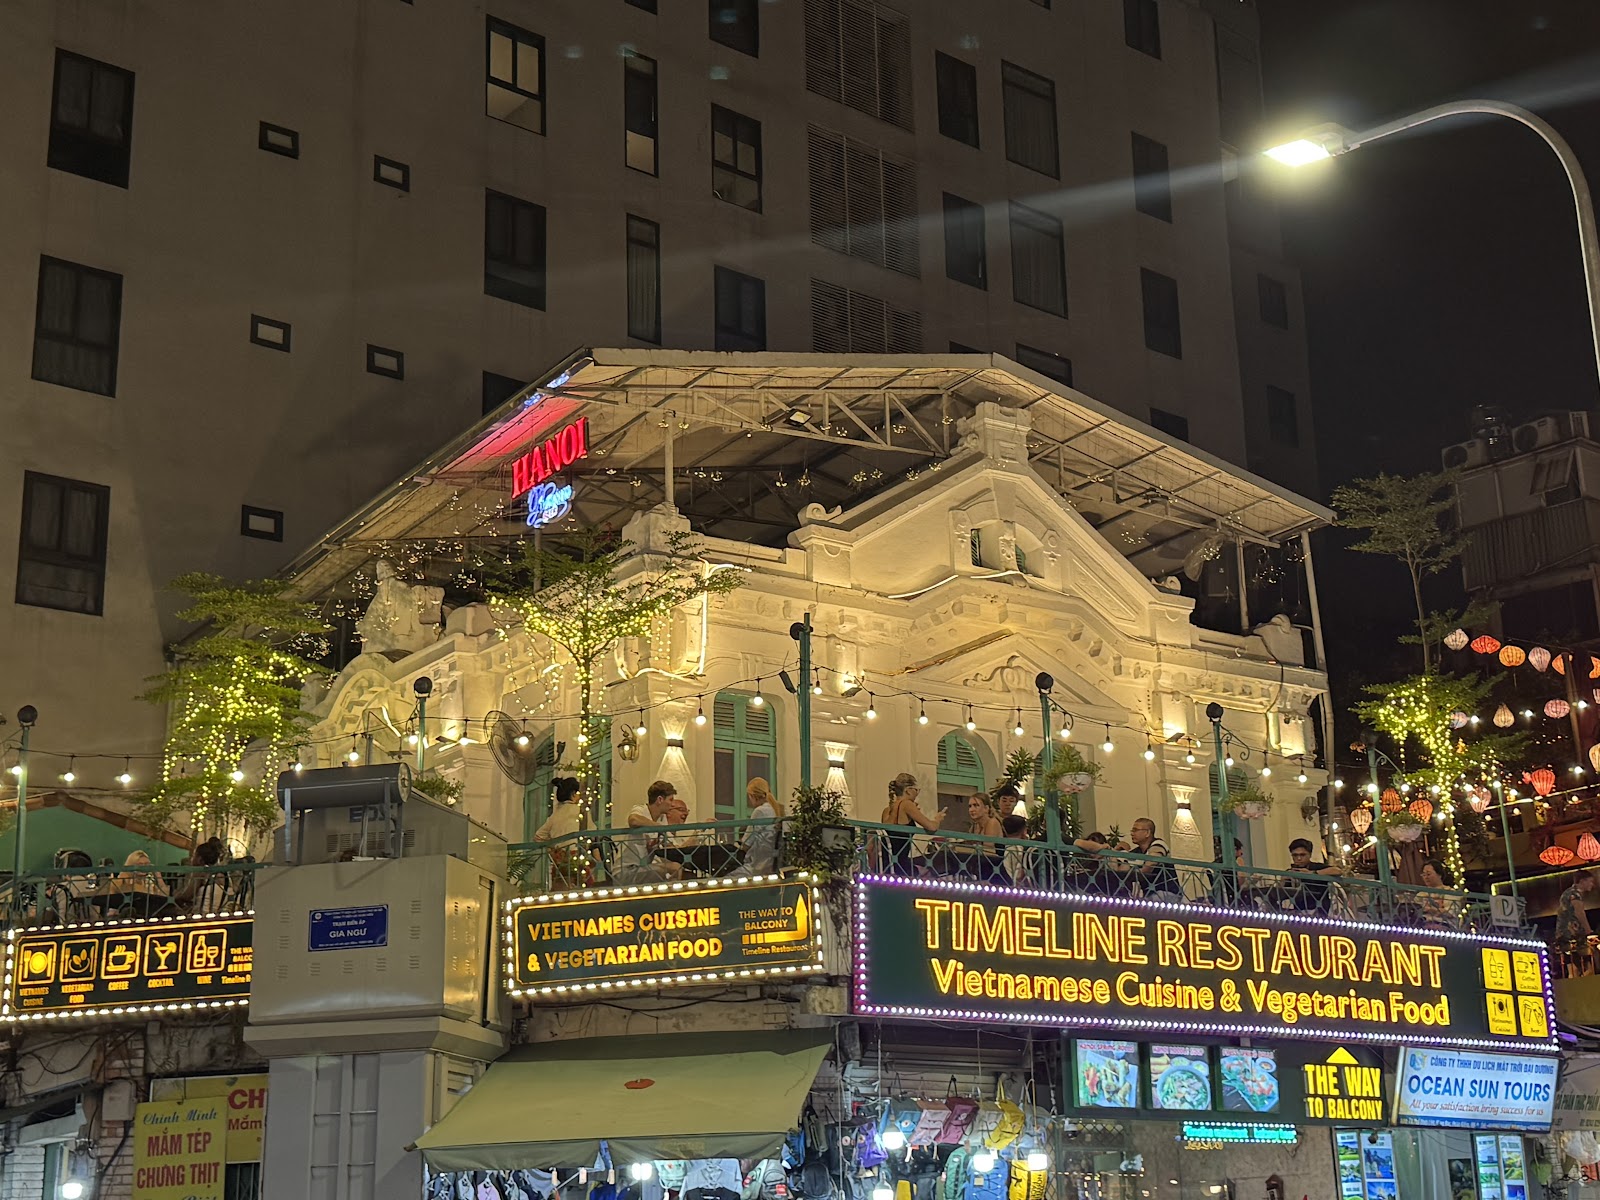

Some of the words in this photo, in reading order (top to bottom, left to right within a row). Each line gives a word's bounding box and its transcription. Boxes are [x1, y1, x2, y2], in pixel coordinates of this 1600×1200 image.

[511, 416, 588, 499] HANOI
[739, 910, 756, 919] THE
[758, 908, 778, 917] WAY
[781, 906, 793, 916] TO
[329, 930, 345, 938] GIA
[528, 913, 635, 941] VIETNAMES
[639, 907, 720, 932] CUISINE
[744, 919, 788, 931] BALCONY
[742, 947, 770, 956] Timeline
[915, 898, 1148, 965] TIMELINE
[1157, 919, 1447, 988] RESTAURANT
[527, 957, 541, 972] &
[545, 943, 665, 969] VEGETARIAN
[668, 937, 723, 960] FOOD
[108, 981, 129, 990] COFFEE
[148, 978, 174, 988] COCKTAIL
[931, 957, 1110, 1004] Vietnamese
[1116, 971, 1214, 1010] Cuisine
[1220, 978, 1242, 1012] &
[1246, 979, 1386, 1023] Vegetarian
[1389, 992, 1450, 1026] Food
[1448, 1058, 1455, 1067] TY
[1473, 1060, 1481, 1070] DU
[1304, 1064, 1339, 1096] THE
[1342, 1067, 1381, 1098] WAY
[1408, 1075, 1465, 1097] OCEAN
[1469, 1079, 1499, 1100] SUN
[1504, 1081, 1551, 1102] TOURS
[228, 1088, 265, 1109] CH
[1306, 1097, 1324, 1118] TO
[1327, 1098, 1383, 1121] BALCONY
[1409, 1098, 1421, 1109] All
[1421, 1101, 1439, 1111] your
[1440, 1101, 1479, 1112] satisfaction
[1480, 1104, 1499, 1115] bring
[1525, 1106, 1535, 1116] for
[228, 1115, 262, 1131] Mắm
[147, 1127, 182, 1157] MẮM
[187, 1128, 212, 1154] TÉP
[137, 1165, 185, 1189] CHƯNG
[190, 1162, 220, 1188] THỊT
